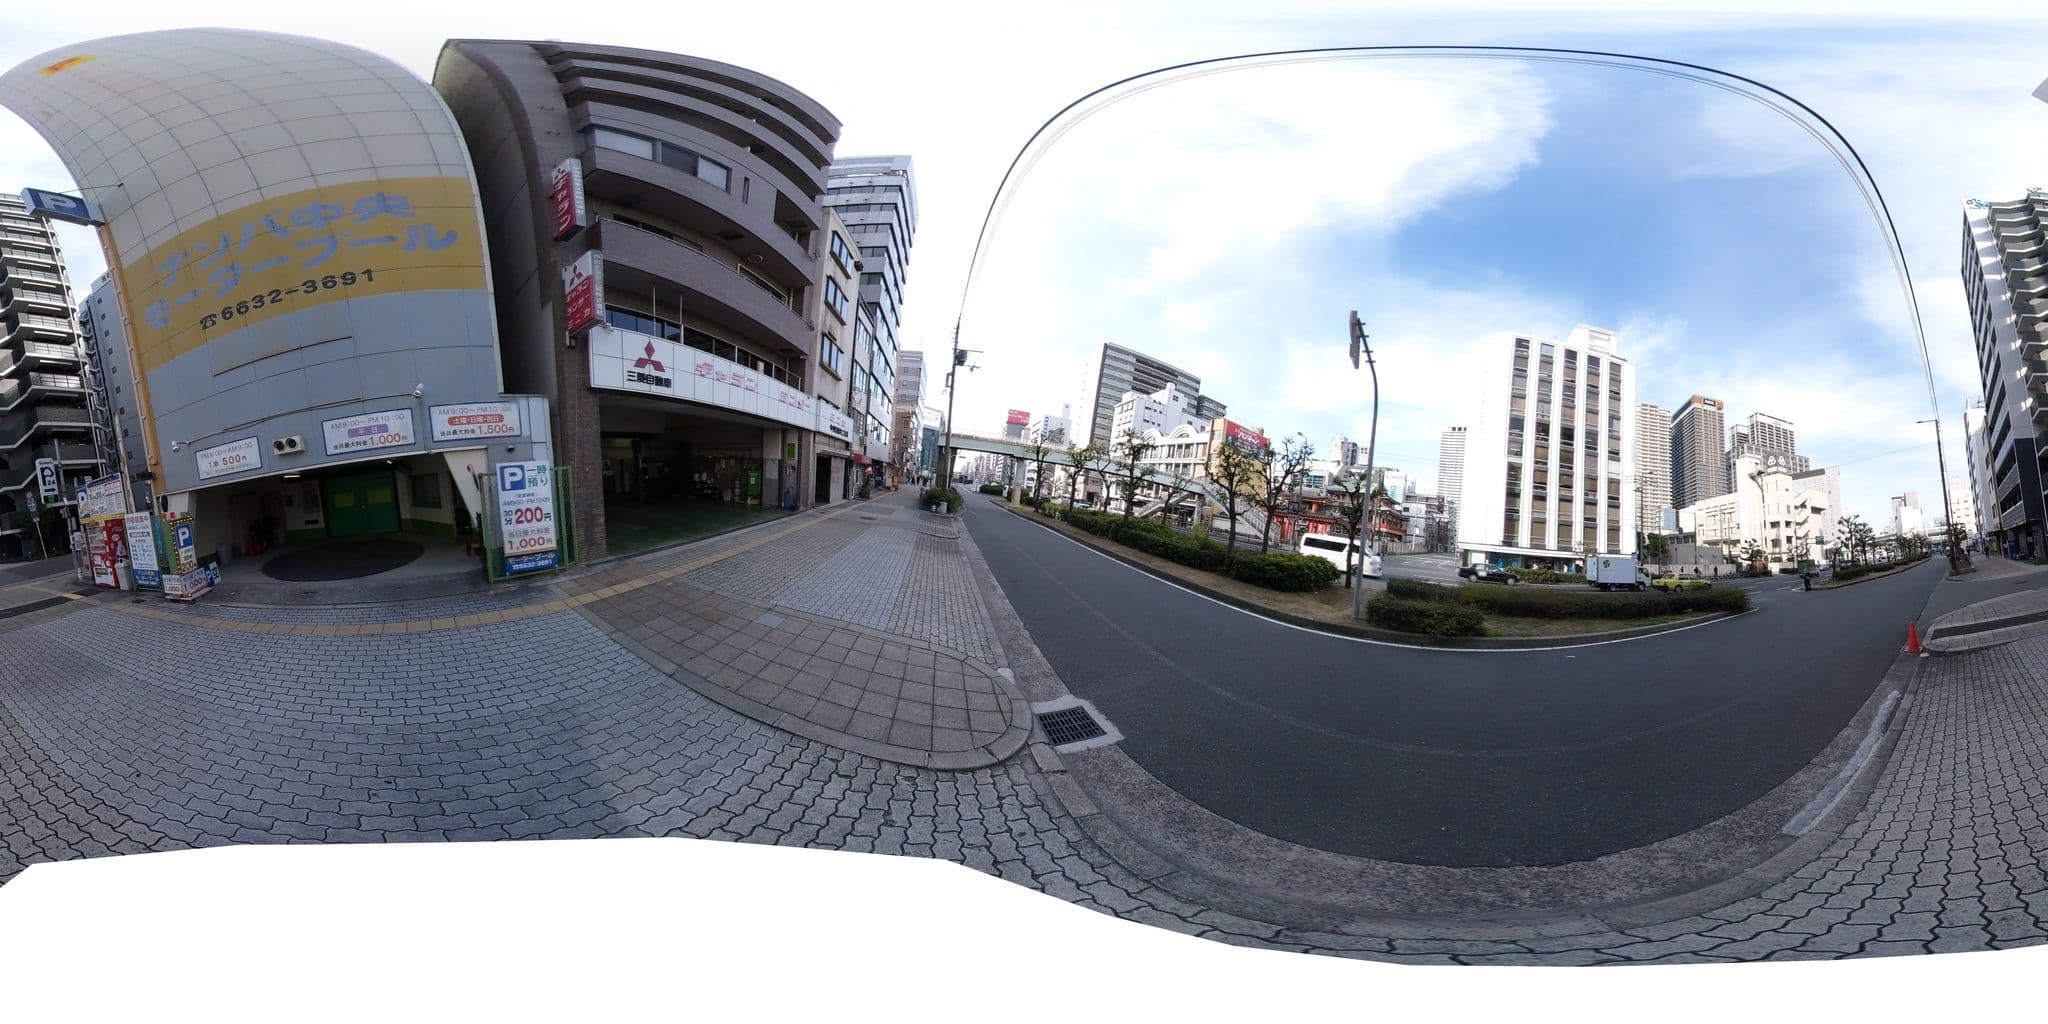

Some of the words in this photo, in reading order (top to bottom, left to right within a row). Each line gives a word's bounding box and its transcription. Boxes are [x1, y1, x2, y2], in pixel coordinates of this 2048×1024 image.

[38, 191, 77, 214] P
[156, 191, 415, 289] ナンバ中央
[144, 221, 459, 330] モータープール
[219, 267, 375, 322] 6632-3691
[626, 369, 673, 388] 三菱自動車
[503, 466, 523, 490] P
[527, 464, 547, 474] 一時
[528, 476, 549, 488] 預り
[514, 506, 552, 525] 200円
[178, 527, 190, 547] P
[507, 536, 553, 550] 1,000円
